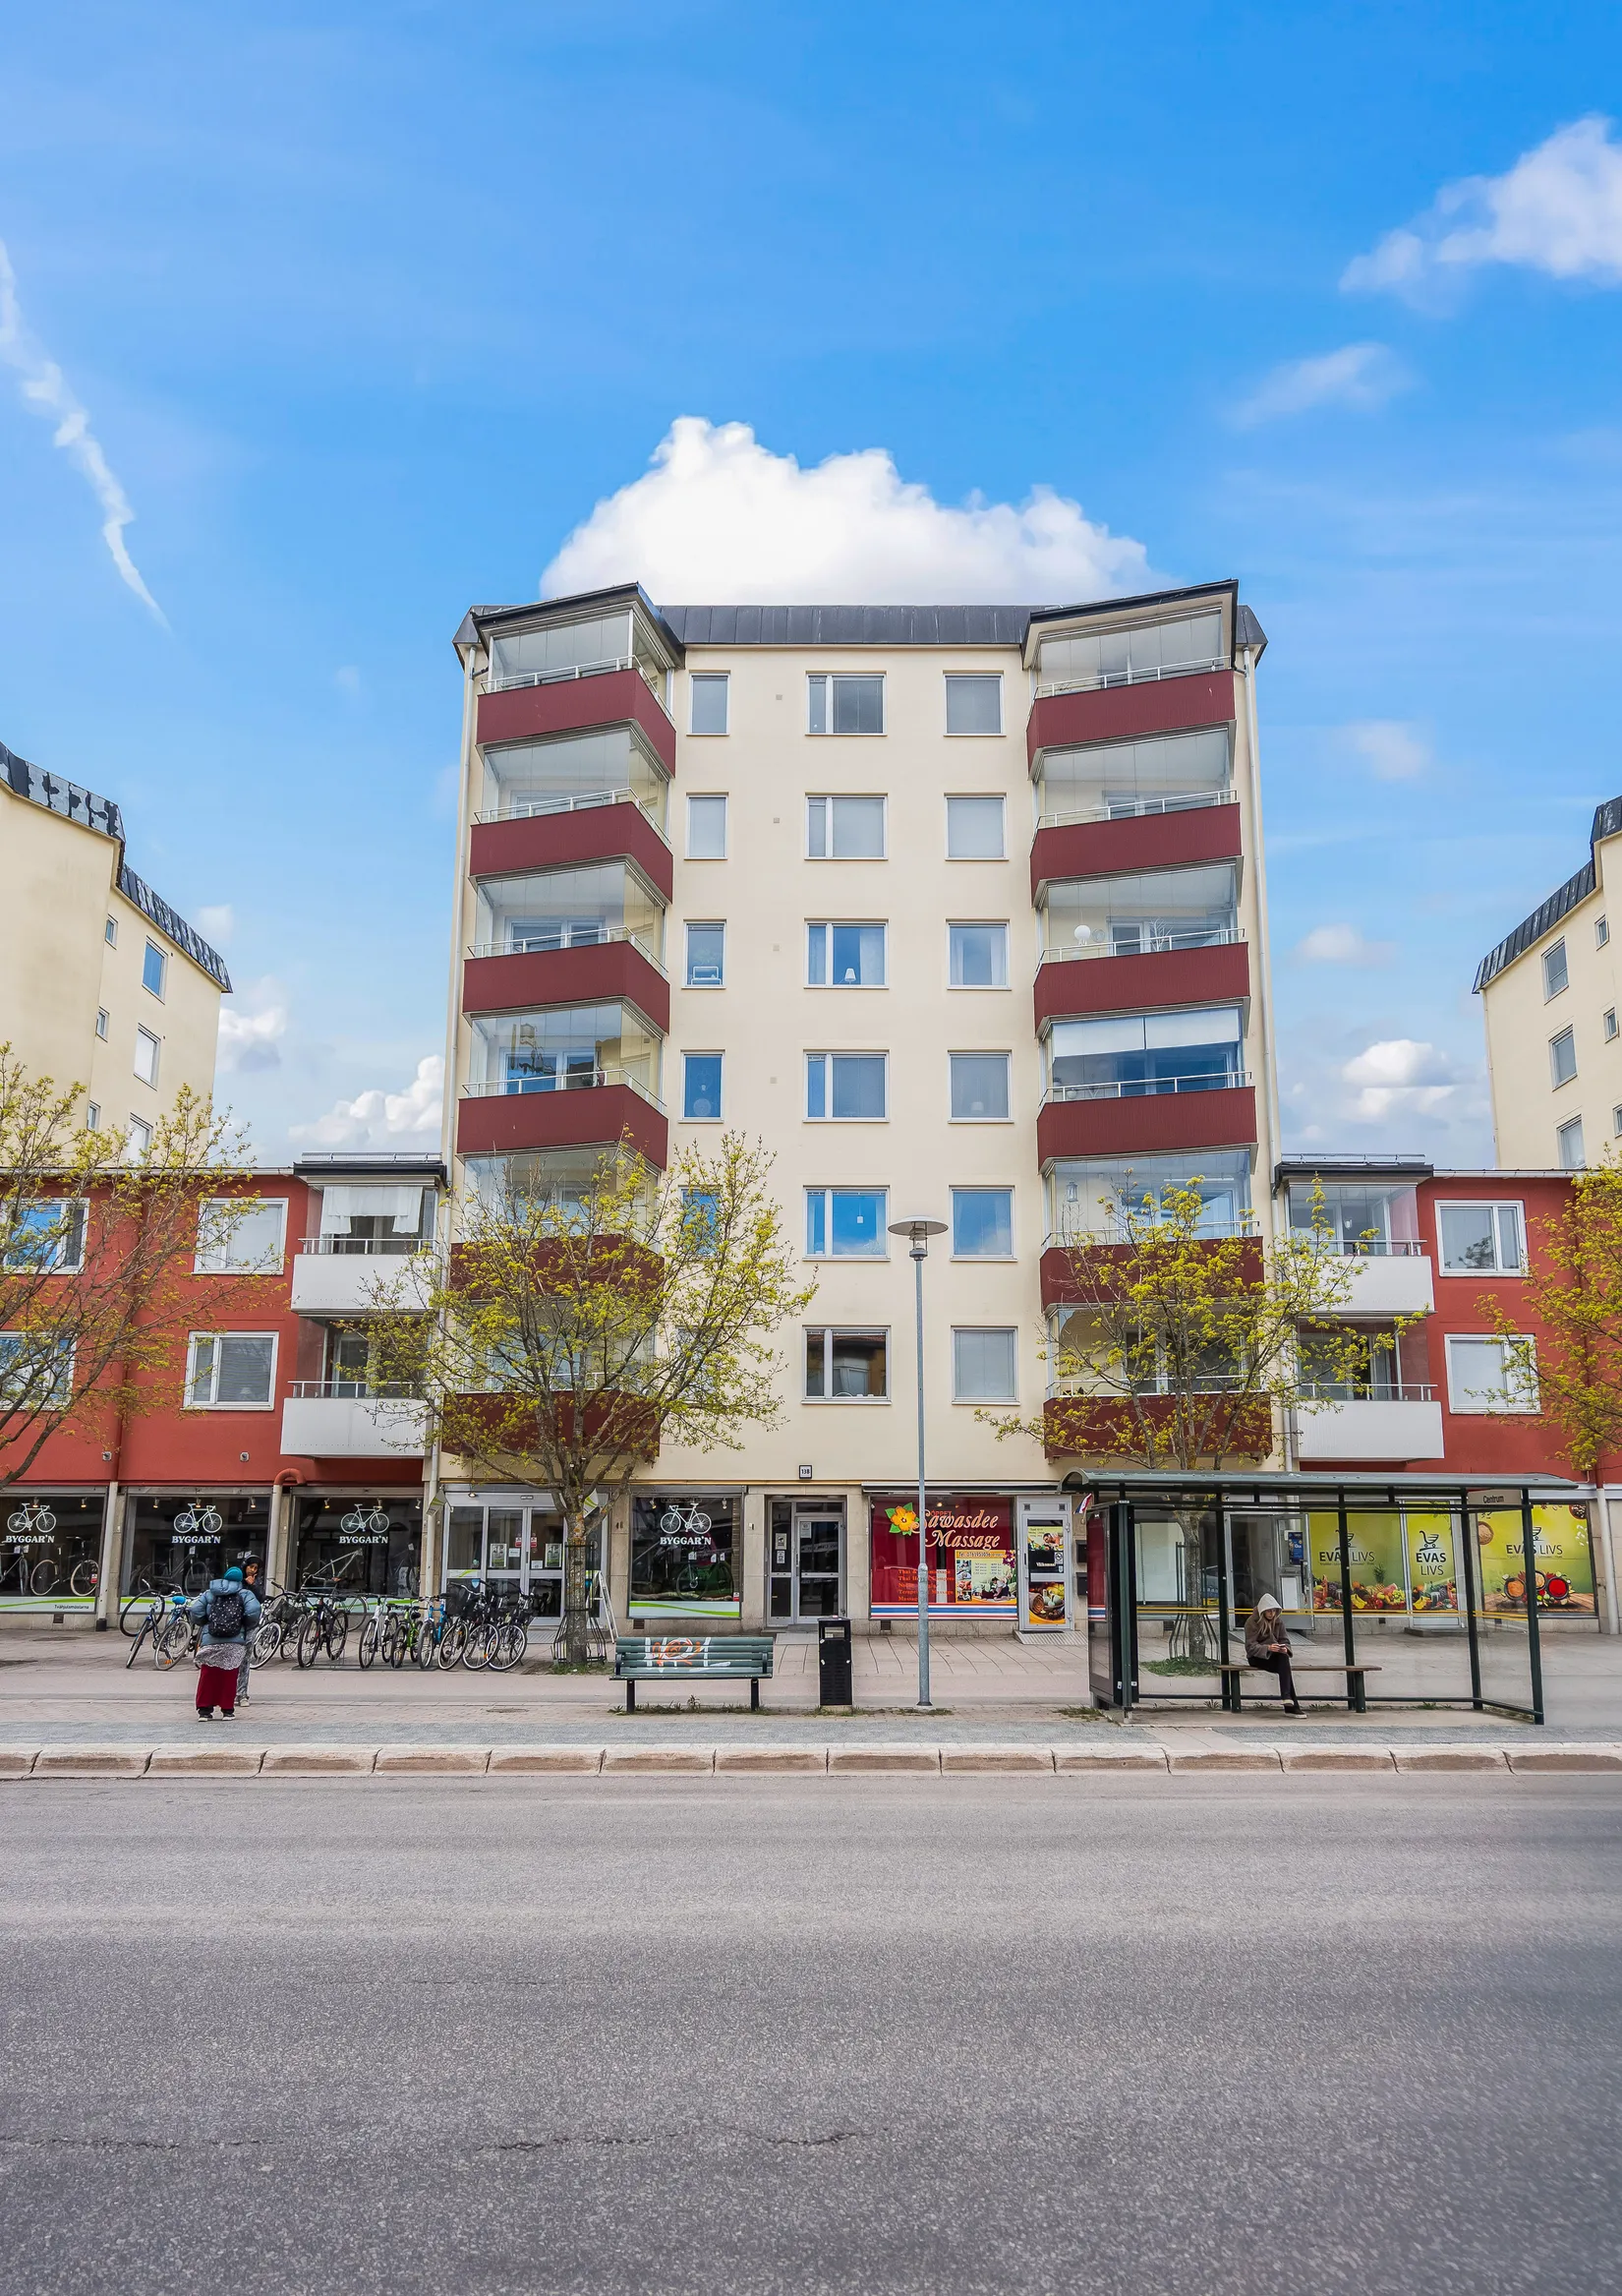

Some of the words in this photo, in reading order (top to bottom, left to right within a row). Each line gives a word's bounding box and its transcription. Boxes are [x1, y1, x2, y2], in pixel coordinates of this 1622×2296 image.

[1482, 1495, 1504, 1503] Centrum
[5, 1535, 55, 1544] BYGGAR'N
[171, 1535, 221, 1544] BYGGAR'N
[339, 1535, 388, 1544] BYGGAR'N
[660, 1536, 712, 1545] BYGGAR'N
[925, 1529, 1001, 1551] Massage
[1539, 1544, 1563, 1555] LIVS
[1319, 1552, 1342, 1561] EVA
[1352, 1552, 1375, 1561] LIVS
[1416, 1553, 1447, 1562] EVAS
[1420, 1564, 1444, 1575] LIVS
